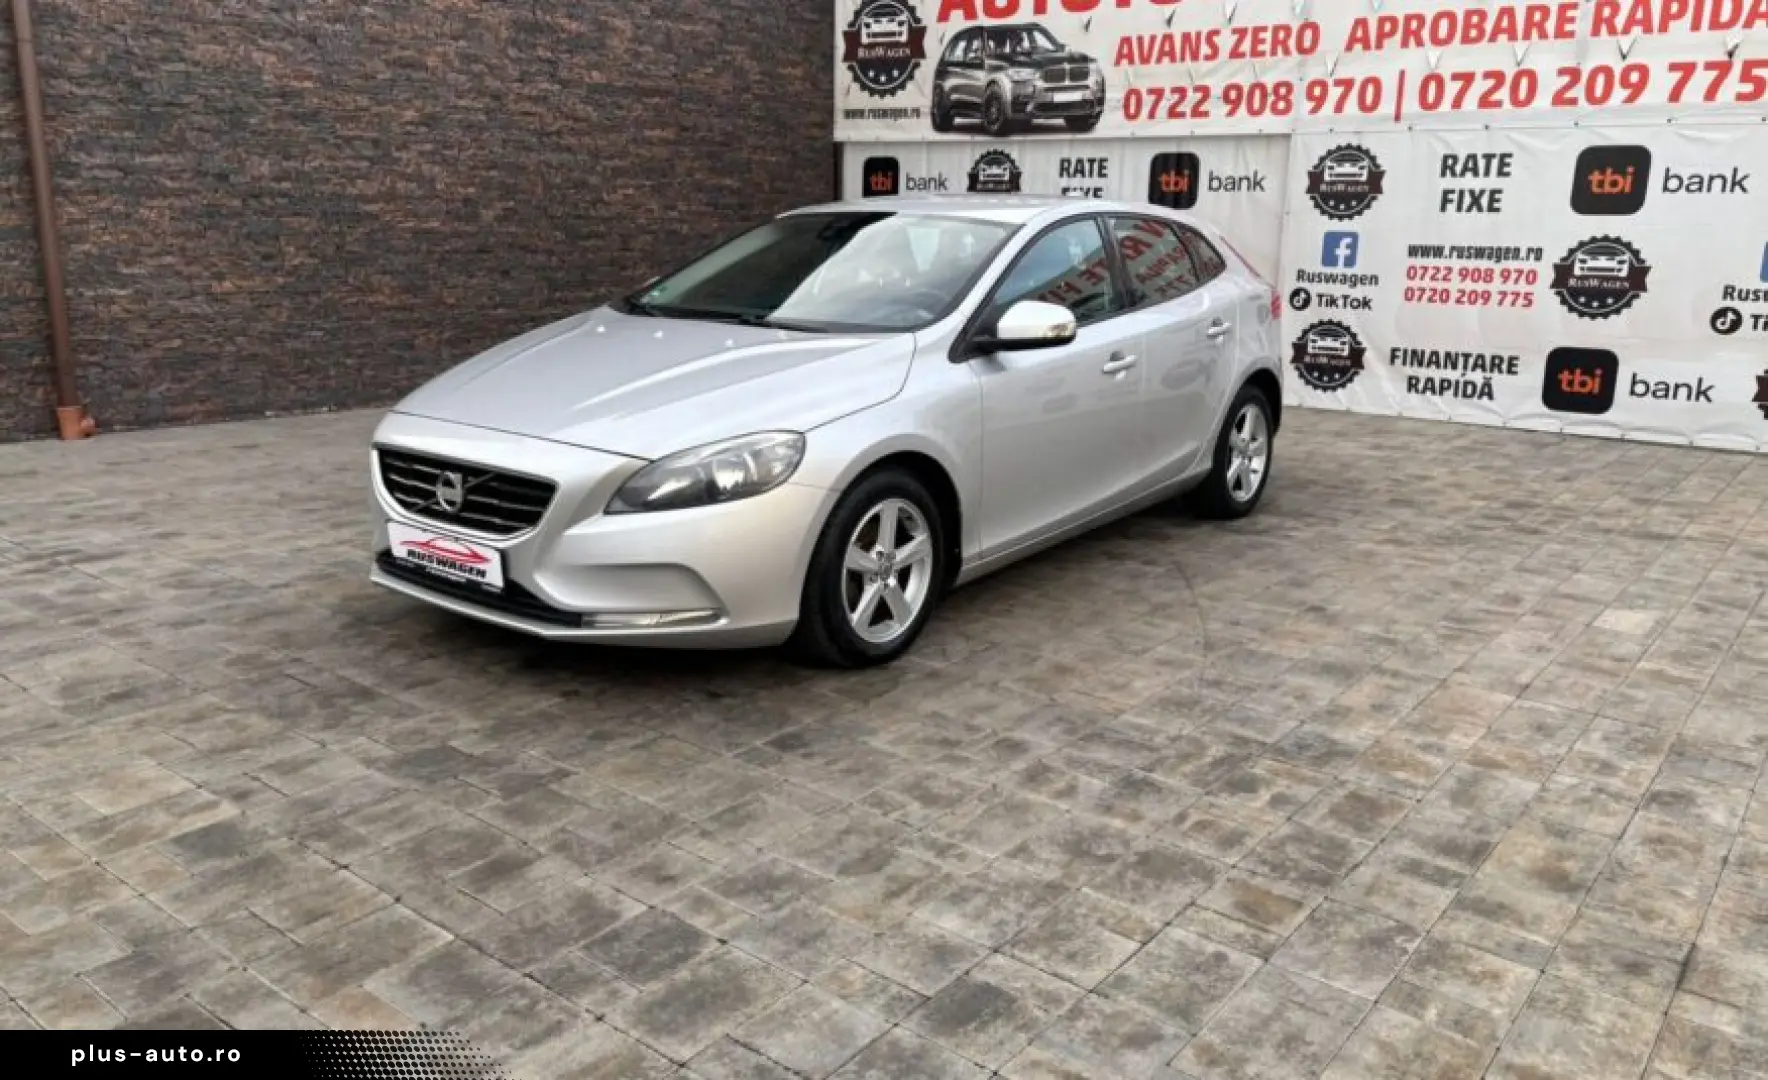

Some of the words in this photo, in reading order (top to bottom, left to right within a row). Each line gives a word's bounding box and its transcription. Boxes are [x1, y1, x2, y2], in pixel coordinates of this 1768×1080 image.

[1114, 28, 1222, 67] AVANS
[1229, 22, 1321, 59] ZERO
[1344, 2, 1580, 52] APROBARE
[1123, 84, 1211, 121] 0722
[1222, 81, 1294, 117] 908
[1306, 76, 1382, 115] 970
[1418, 67, 1538, 111] 0720
[1552, 63, 1649, 108] 209
[1667, 58, 1768, 103] 775
[1059, 157, 1108, 178] RATE
[1439, 152, 1514, 178] RATE
[869, 172, 892, 191] tbi
[905, 172, 948, 191] bank
[1160, 170, 1189, 193] tbi
[1208, 170, 1266, 192] bank
[1588, 165, 1635, 195] tbi
[1662, 167, 1750, 194] bank
[1438, 187, 1504, 213] FIXE
[1406, 243, 1544, 263] www.ruswagen.ro
[1296, 269, 1379, 289] Ruswagen
[1406, 265, 1453, 282] 0722
[1458, 267, 1495, 284] 908
[1499, 268, 1538, 286] 970
[1315, 293, 1373, 311] TikTok
[1404, 287, 1450, 304] 0720
[1455, 289, 1492, 306] 209
[1497, 291, 1535, 308] 775
[1722, 283, 1768, 302] Rus
[1406, 375, 1495, 401] RAPIDĂ
[1557, 367, 1603, 394] tbi
[1629, 372, 1715, 403] bank
